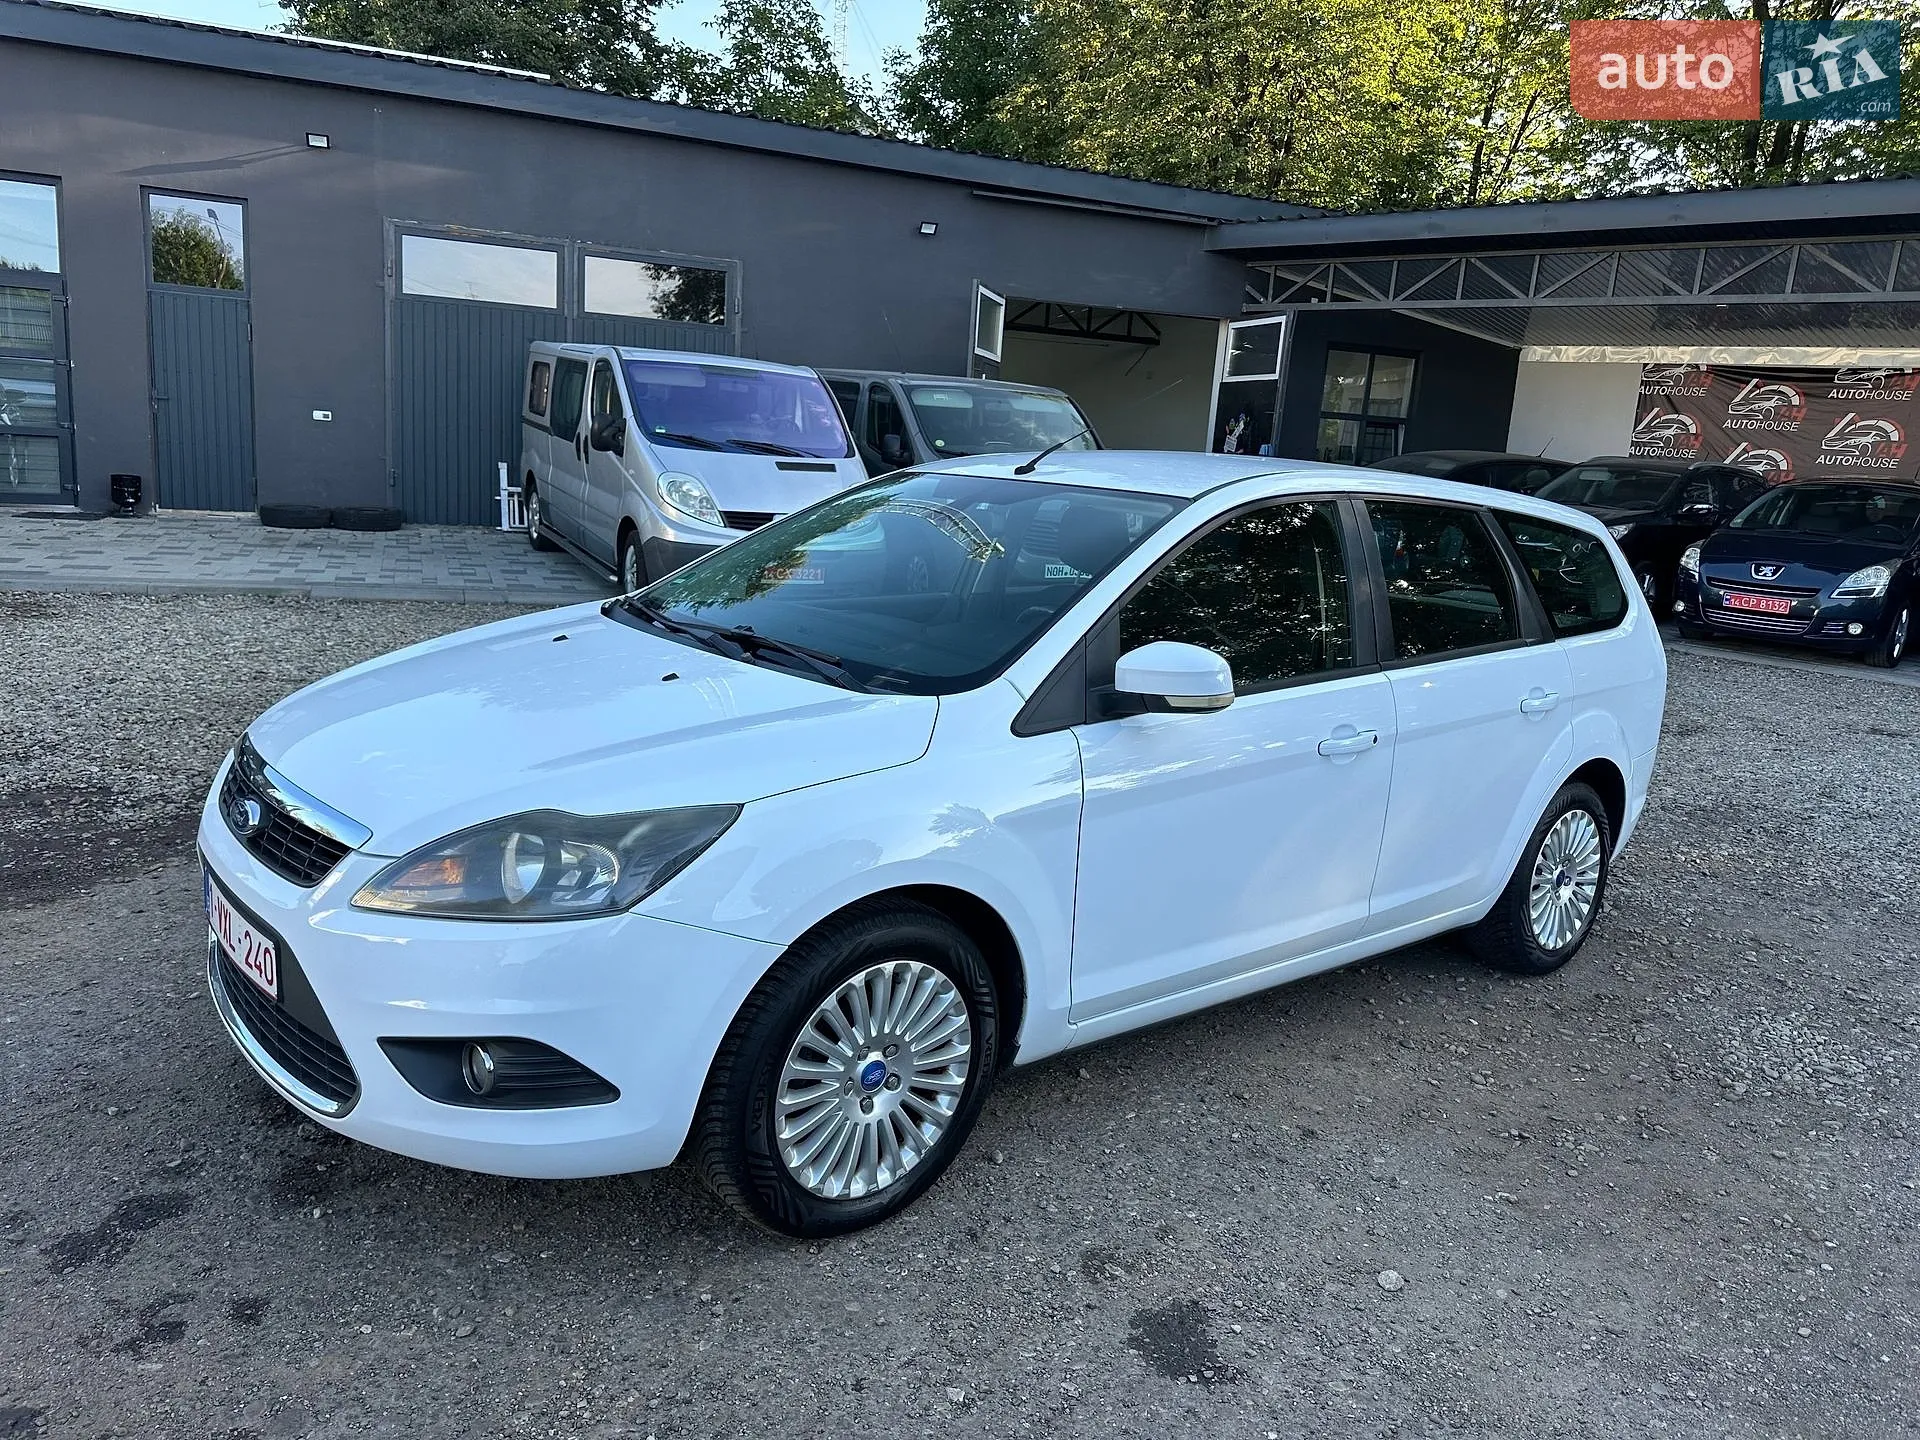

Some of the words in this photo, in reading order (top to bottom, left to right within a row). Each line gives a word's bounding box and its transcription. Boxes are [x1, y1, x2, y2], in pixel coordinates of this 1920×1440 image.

[1639, 386, 1708, 397] AUTOHOUSE
[1828, 389, 1914, 401] AUTOHOUSE
[1722, 419, 1800, 432] AUTOHOUSE
[1629, 446, 1698, 459] AUTOHOUSE
[1815, 454, 1900, 469] AUTOHOUSE
[1759, 600, 1786, 612] 8132
